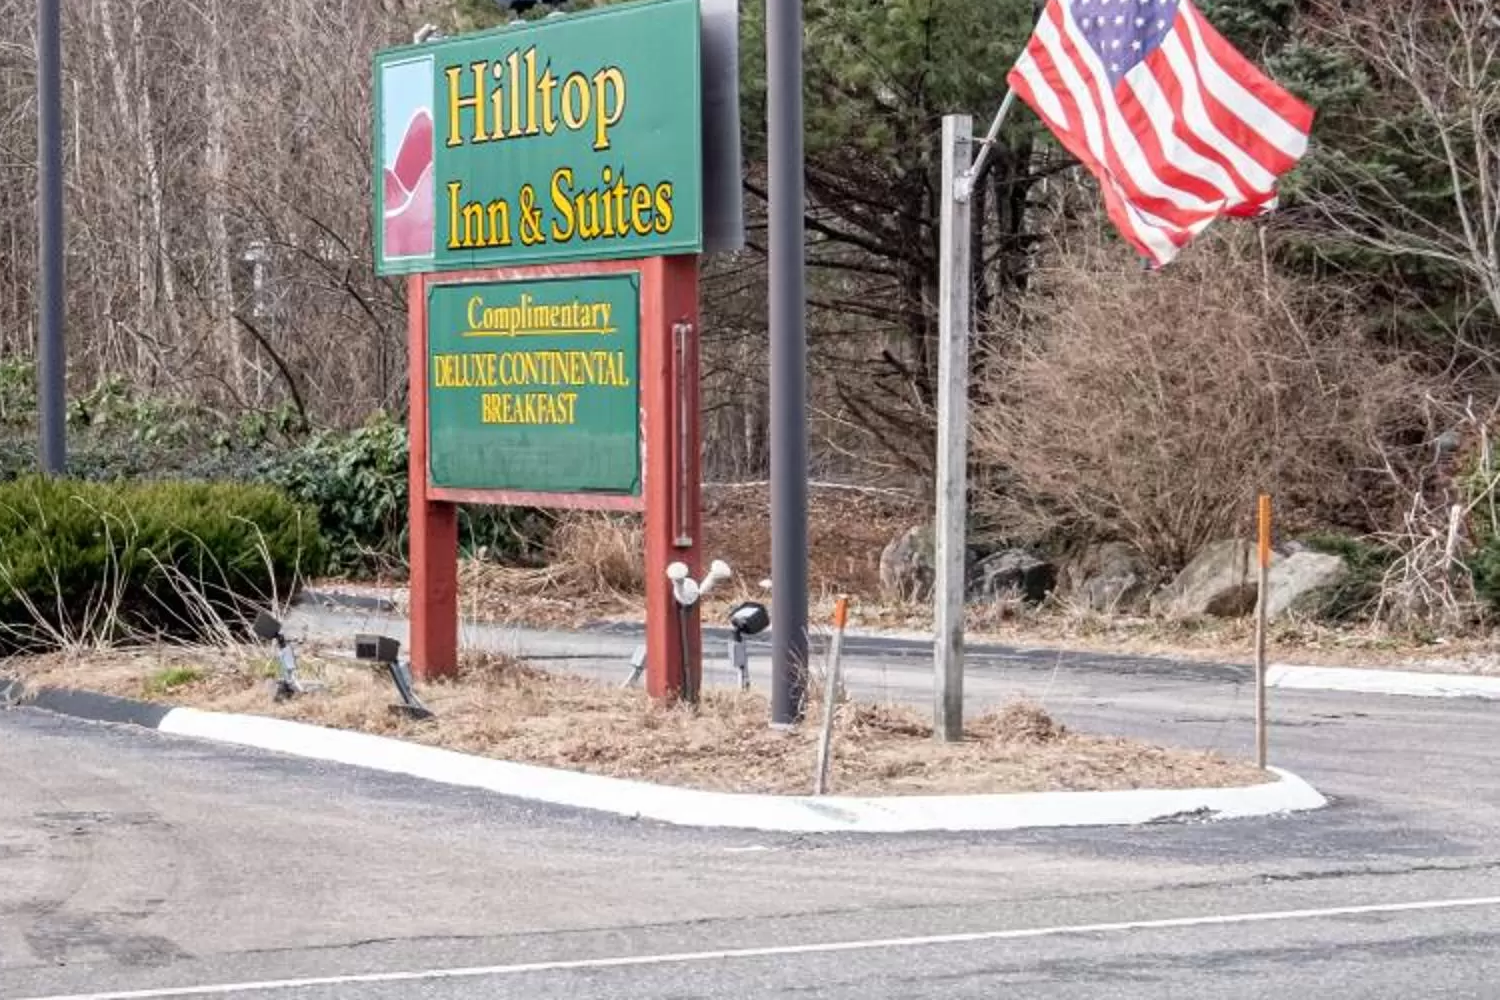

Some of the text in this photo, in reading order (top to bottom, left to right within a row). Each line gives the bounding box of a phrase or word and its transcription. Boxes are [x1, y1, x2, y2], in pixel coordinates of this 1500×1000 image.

[445, 45, 626, 150] Hilltop
[447, 165, 674, 249] Inn & Suites
[467, 294, 612, 337] Complimentary
[434, 350, 630, 388] DELUXE CONTINENTAL
[481, 393, 578, 425] BREAKFAST
